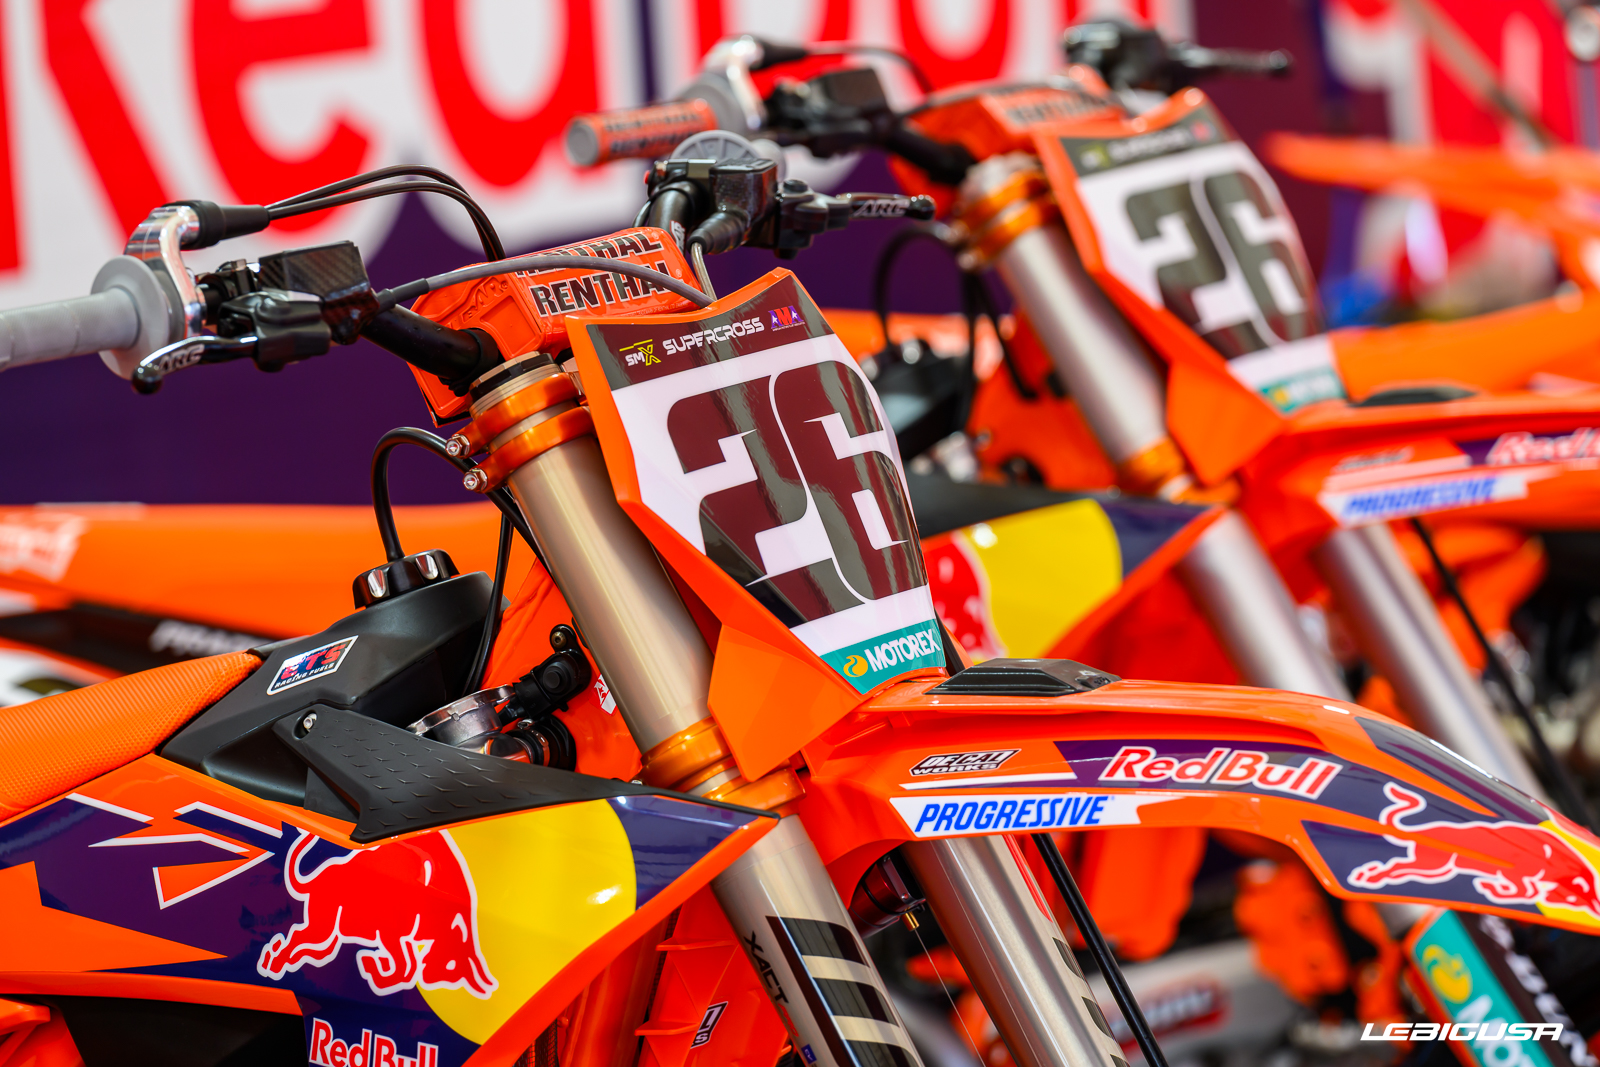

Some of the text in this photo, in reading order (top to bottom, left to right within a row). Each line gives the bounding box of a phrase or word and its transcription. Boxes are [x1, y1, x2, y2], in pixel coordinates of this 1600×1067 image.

[1126, 172, 1328, 360] 26
[662, 317, 765, 355] SUPERCROSS
[667, 360, 928, 630] 26
[280, 643, 347, 680] ETS
[864, 629, 941, 672] MOTOREX
[913, 762, 998, 776] WORKS
[919, 750, 1015, 768] DECAL
[1098, 746, 1343, 800] Red Bull
[914, 796, 1109, 833] PROGRESSIVE
[743, 931, 789, 1004] XACT
